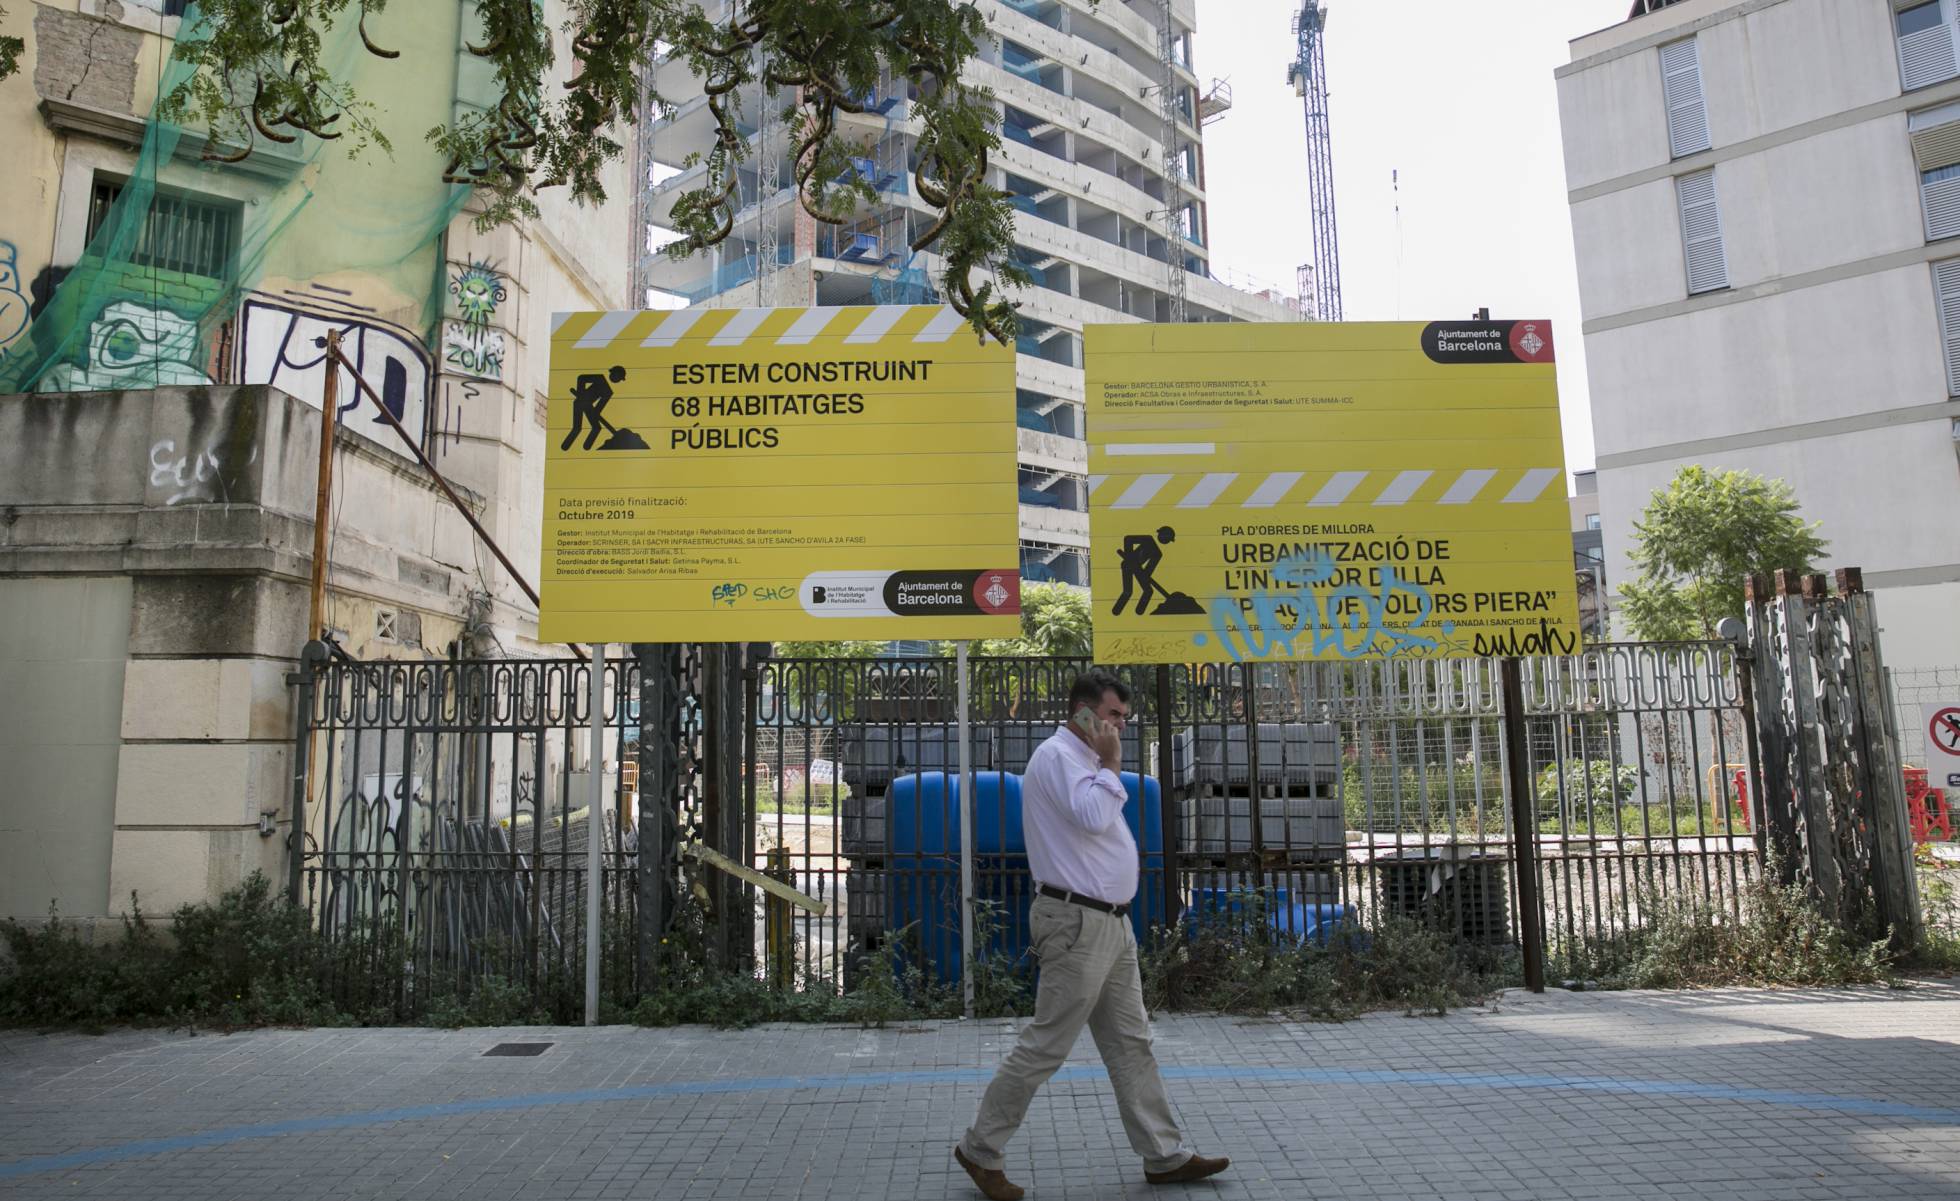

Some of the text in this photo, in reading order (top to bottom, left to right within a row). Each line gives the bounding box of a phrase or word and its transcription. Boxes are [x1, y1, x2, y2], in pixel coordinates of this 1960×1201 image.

[1438, 329, 1501, 340] Ajuntament de
[1438, 340, 1502, 351] Barcelona
[672, 360, 933, 385] ESTEM CONSTRUINT
[1104, 391, 1138, 399] Operador:
[671, 393, 864, 417] 68 HABITATGES
[1234, 398, 1268, 407] Seguretat
[671, 422, 779, 449] PÚBLICS
[559, 496, 688, 509] Data previsió finalització:
[559, 510, 635, 520] Octubre 2019
[557, 529, 583, 537] Gestor:
[612, 529, 645, 538] Municipal
[1221, 524, 1375, 536] PLA D'OBRES DE MILLORA
[557, 539, 591, 547] Operador:
[1223, 535, 1450, 563] URBANITZACIÓ DE
[610, 558, 644, 567] Seguretat
[649, 557, 670, 565] Salut:
[556, 567, 585, 575] Direcció
[898, 581, 963, 592] Ajuntament de
[897, 593, 963, 606] Barcelona
[1369, 592, 1467, 615] OLORS
[1490, 618, 1525, 626] SANCHO
[1526, 617, 1537, 625] DE
